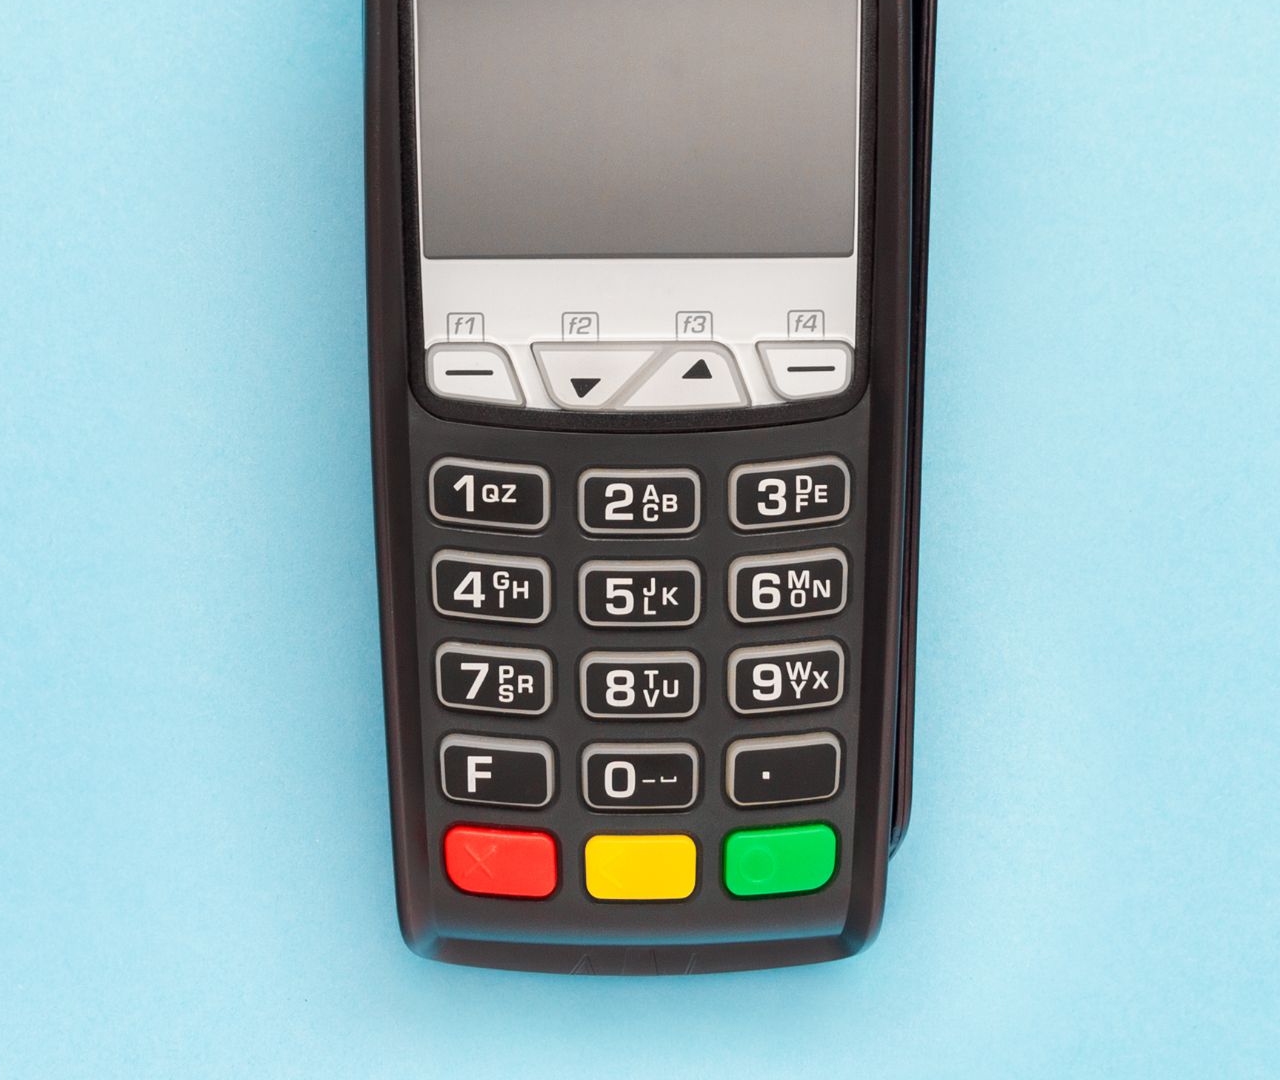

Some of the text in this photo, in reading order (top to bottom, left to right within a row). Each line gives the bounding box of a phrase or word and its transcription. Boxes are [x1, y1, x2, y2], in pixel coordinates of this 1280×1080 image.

[454, 316, 476, 335] f1
[568, 316, 592, 335] f2
[683, 315, 707, 334] f3
[794, 314, 818, 333] f4
[452, 474, 475, 512] 1
[604, 482, 634, 521] 2
[757, 478, 787, 516] 3
[453, 571, 486, 608] 4
[605, 577, 635, 616] 5
[751, 572, 781, 610] 6
[460, 662, 490, 700] 7
[605, 669, 636, 708] 8
[752, 663, 783, 702] 9
[467, 755, 493, 793] F
